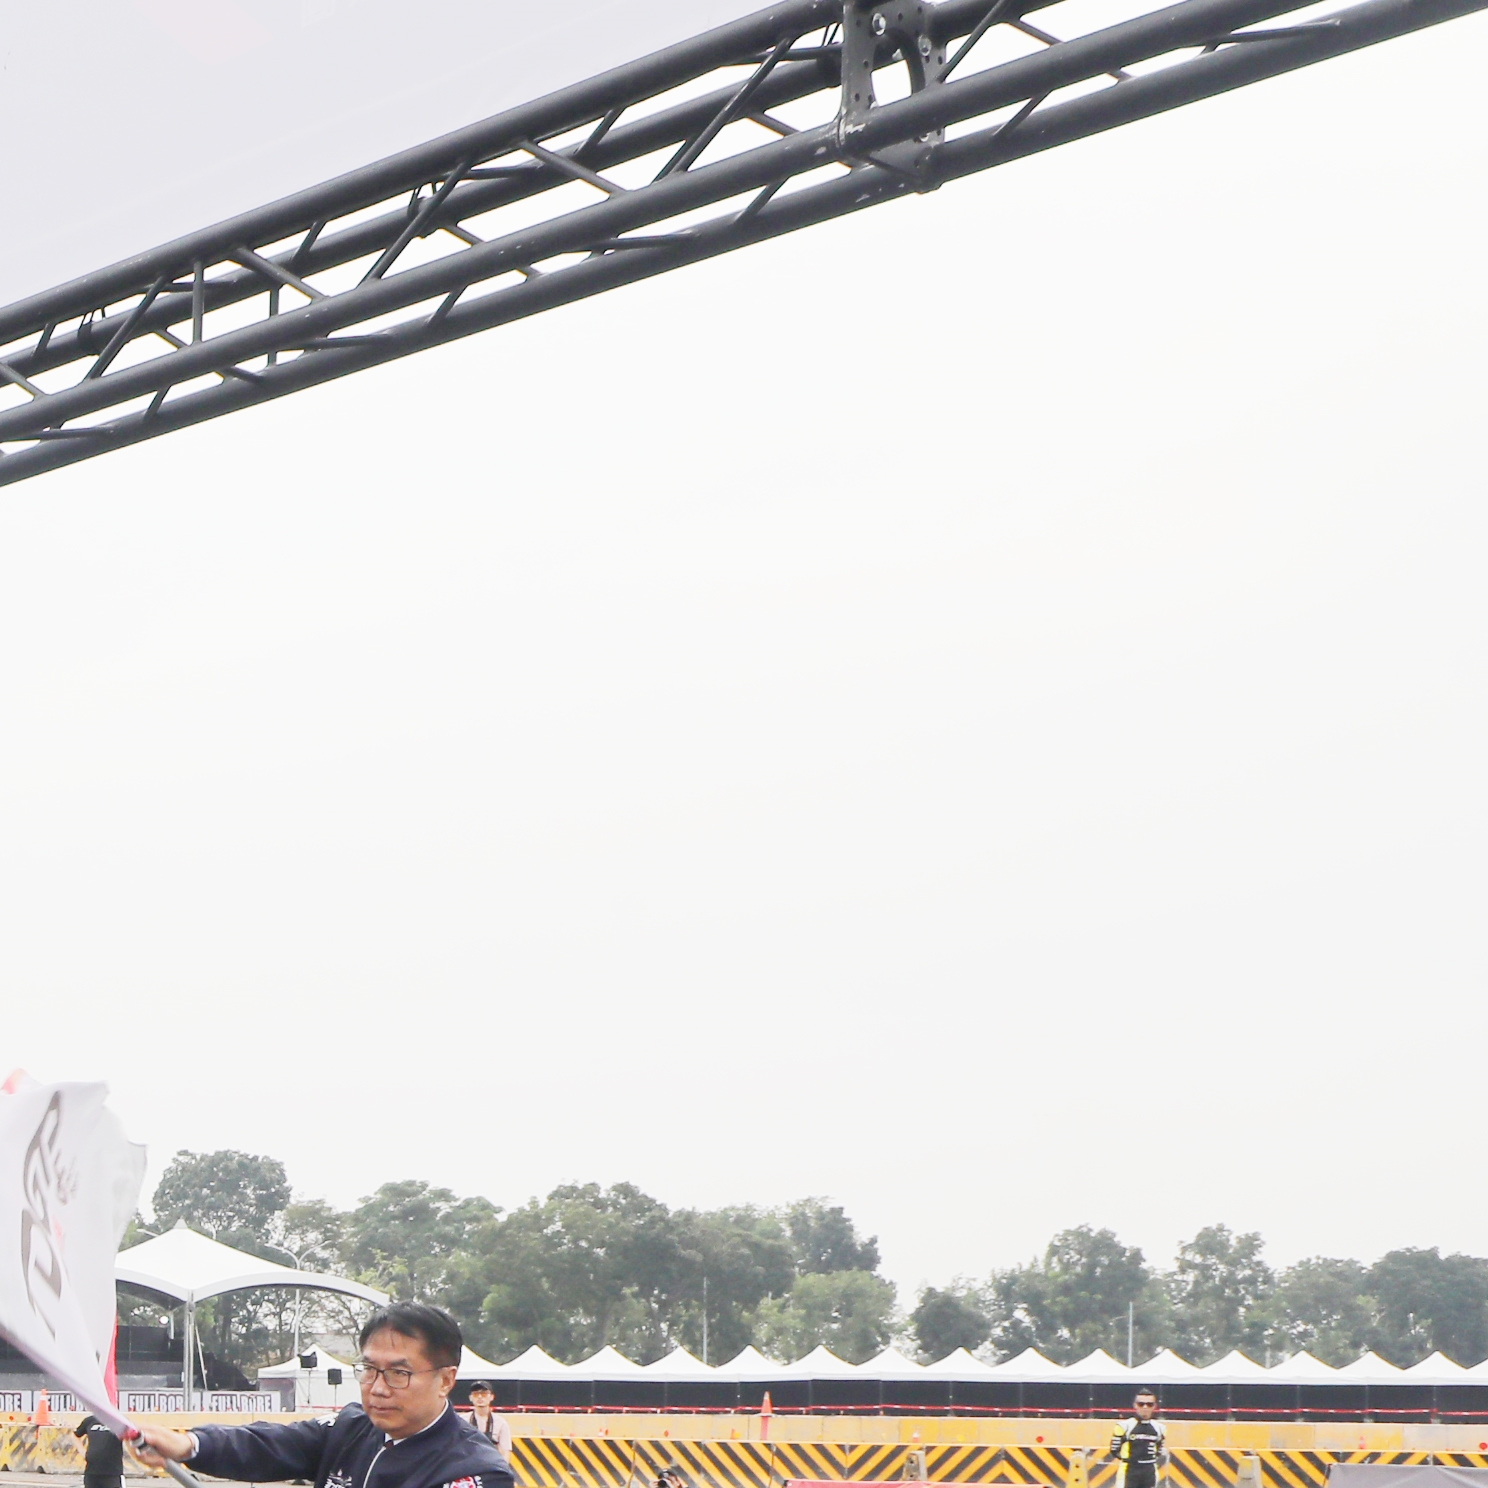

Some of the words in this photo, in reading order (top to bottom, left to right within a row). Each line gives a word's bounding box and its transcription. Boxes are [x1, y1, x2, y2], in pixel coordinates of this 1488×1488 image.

[128, 1394, 156, 1413] FULL
[158, 1394, 185, 1413] BOR
[211, 1394, 239, 1413] FULL
[241, 1394, 273, 1413] BORE
